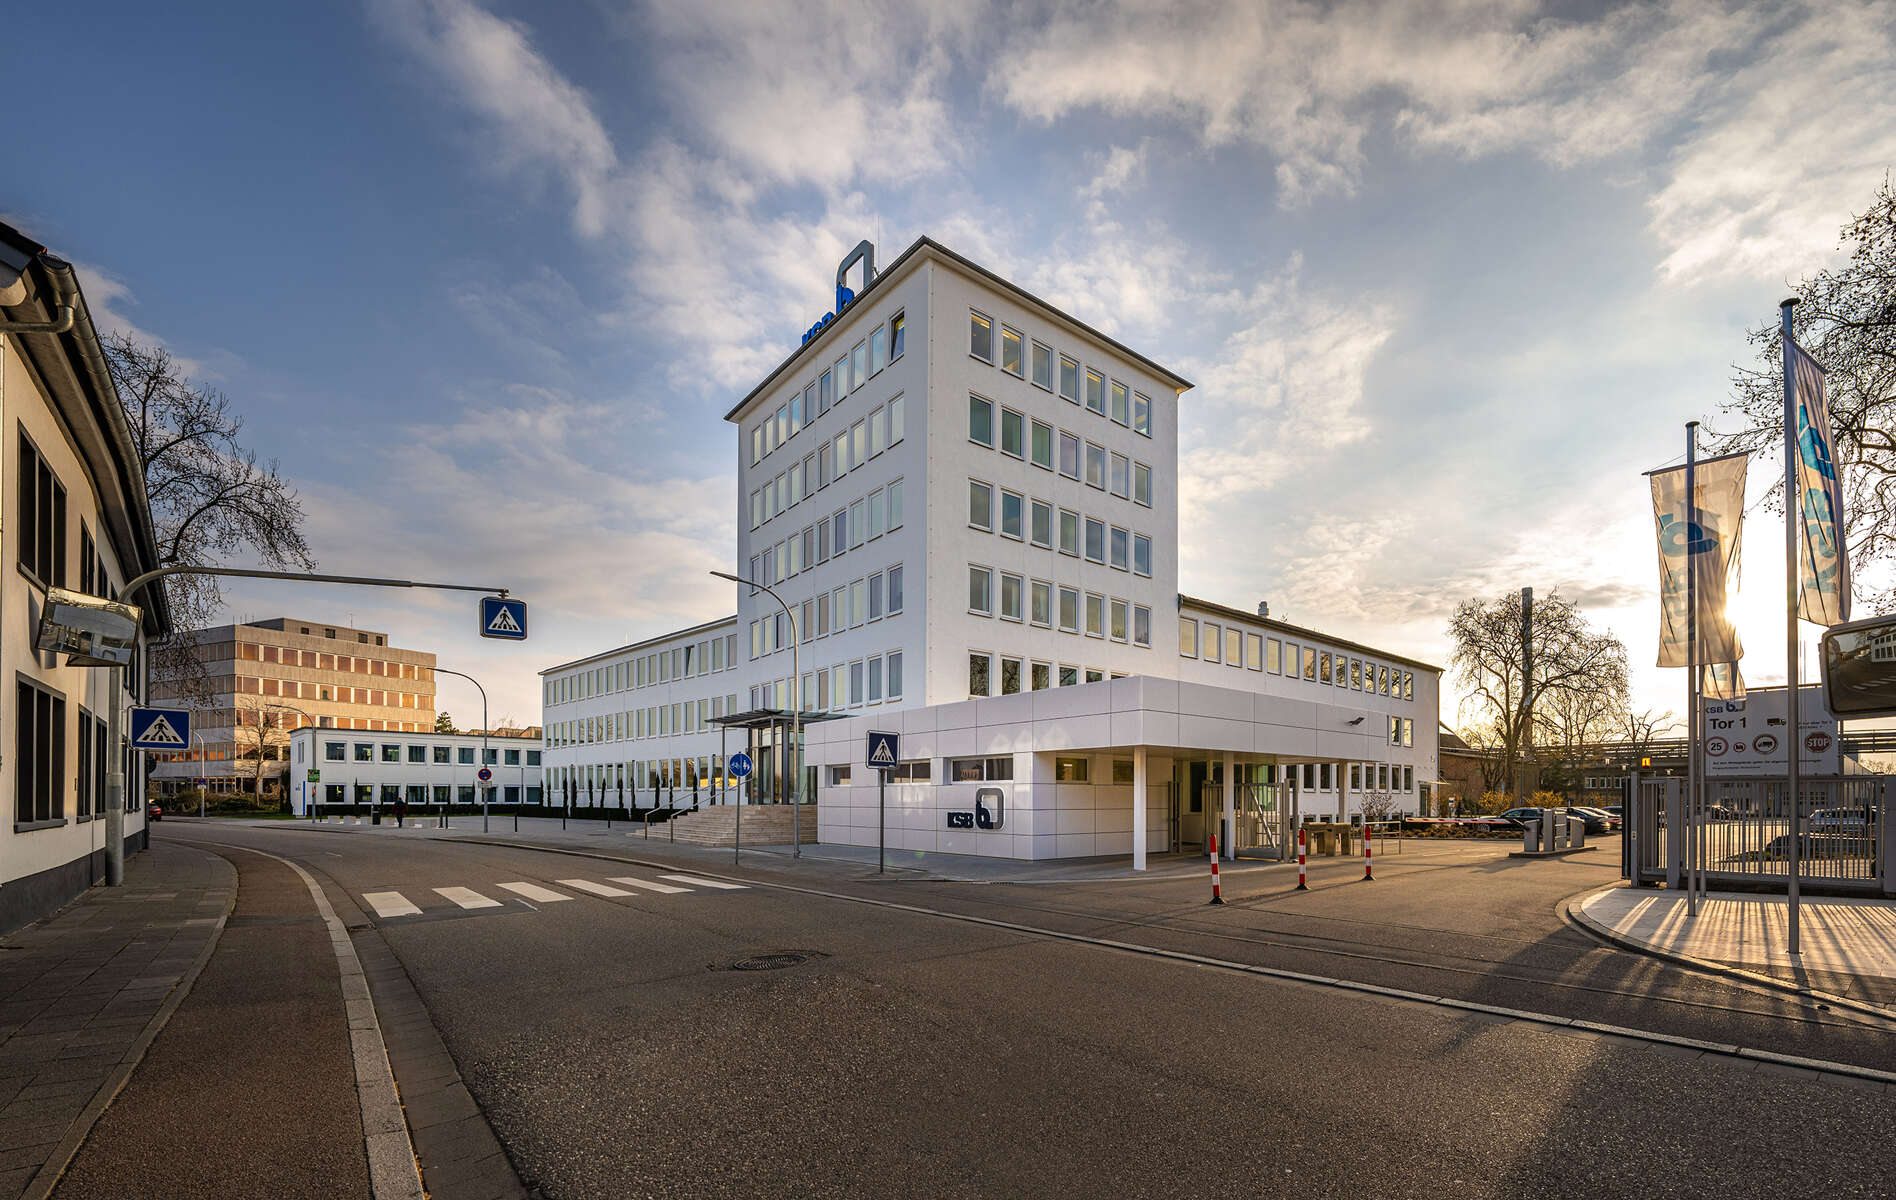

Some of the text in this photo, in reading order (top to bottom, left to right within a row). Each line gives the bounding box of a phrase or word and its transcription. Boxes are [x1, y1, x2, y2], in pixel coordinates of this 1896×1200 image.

[1709, 717, 1746, 729] Tor 1
[1710, 742, 1722, 751] 25
[1807, 738, 1829, 747] STOP
[947, 812, 974, 828] KSB
